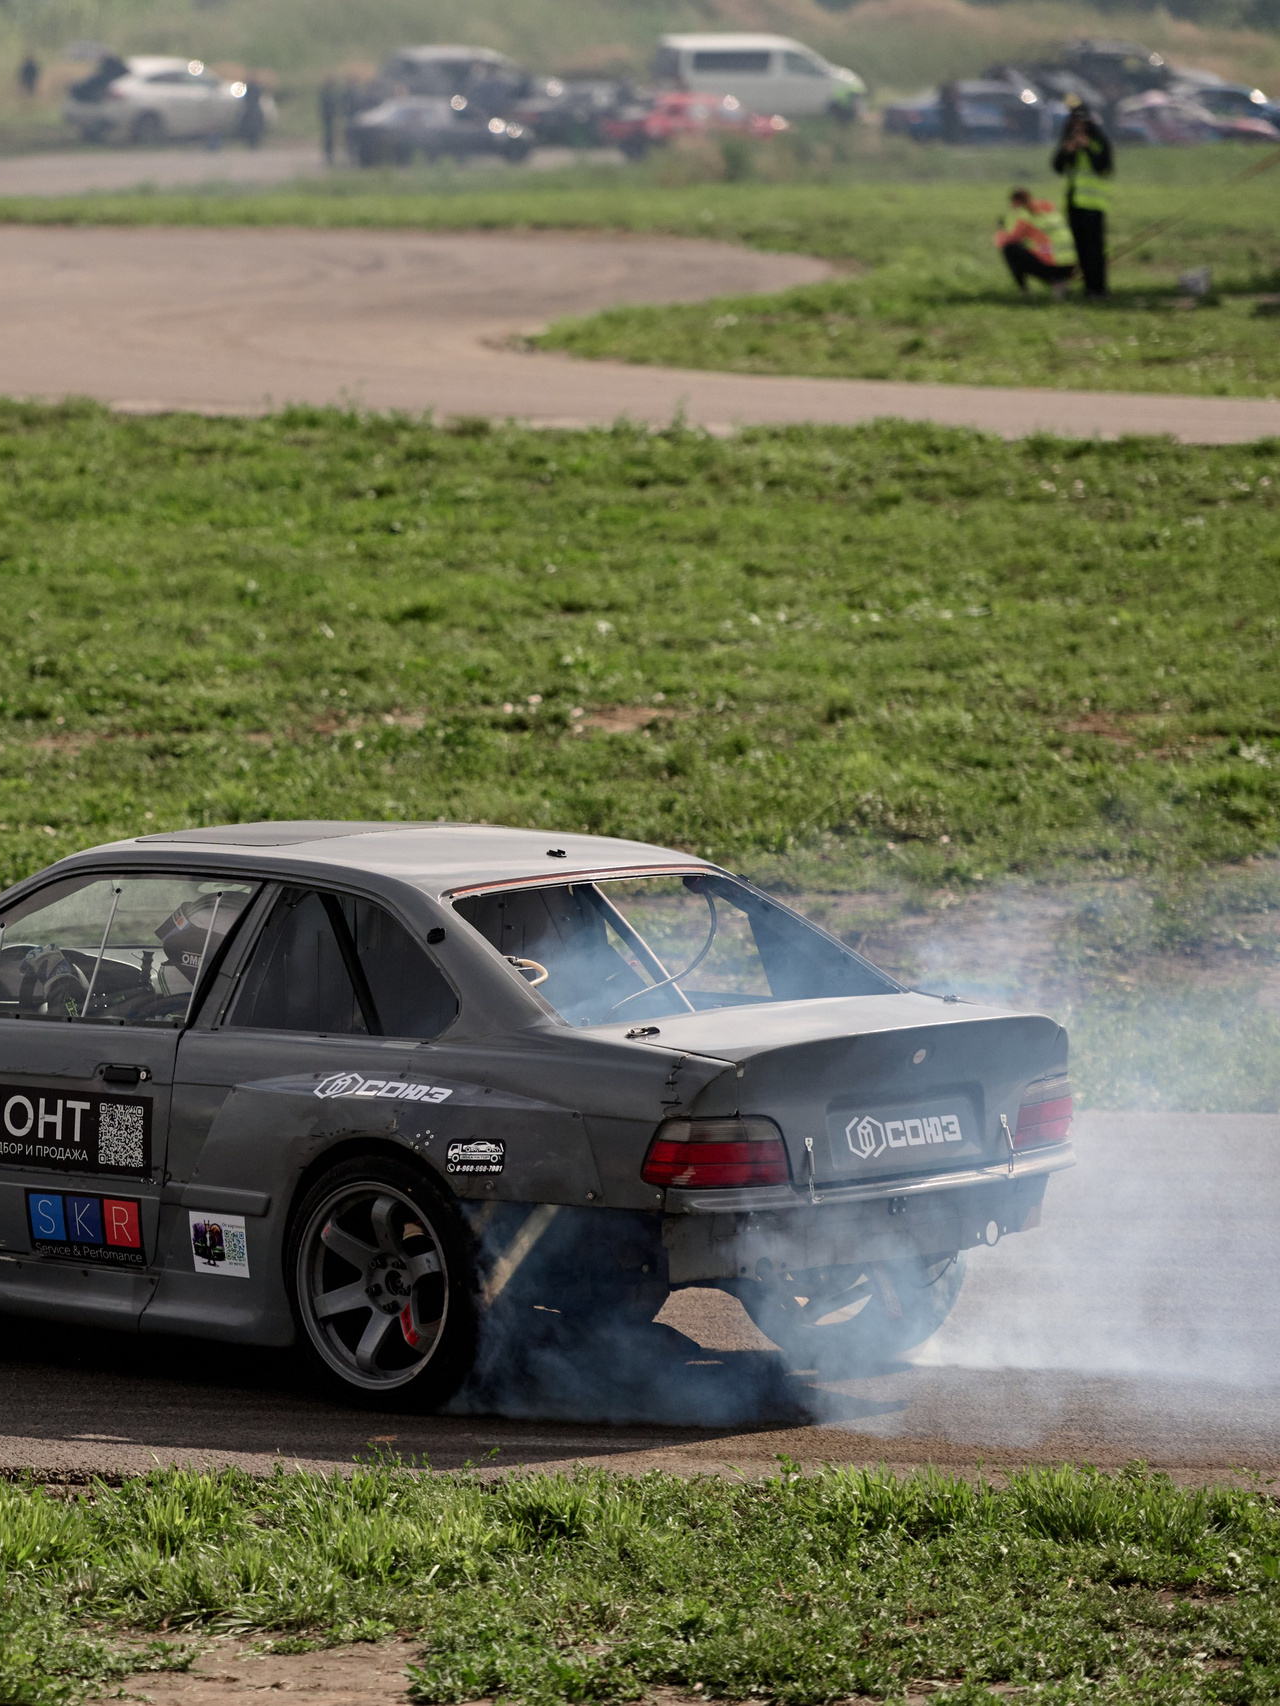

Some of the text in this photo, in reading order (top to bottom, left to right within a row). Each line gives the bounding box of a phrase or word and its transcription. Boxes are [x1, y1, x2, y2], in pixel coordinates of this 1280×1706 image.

[355, 1079, 453, 1104] СОЮЗ
[884, 1114, 963, 1148] СОЮЗ
[25, 1144, 33, 1156] И
[35, 1145, 89, 1162] ПРОДАЖА
[35, 1242, 143, 1263] Service & Perfomance
